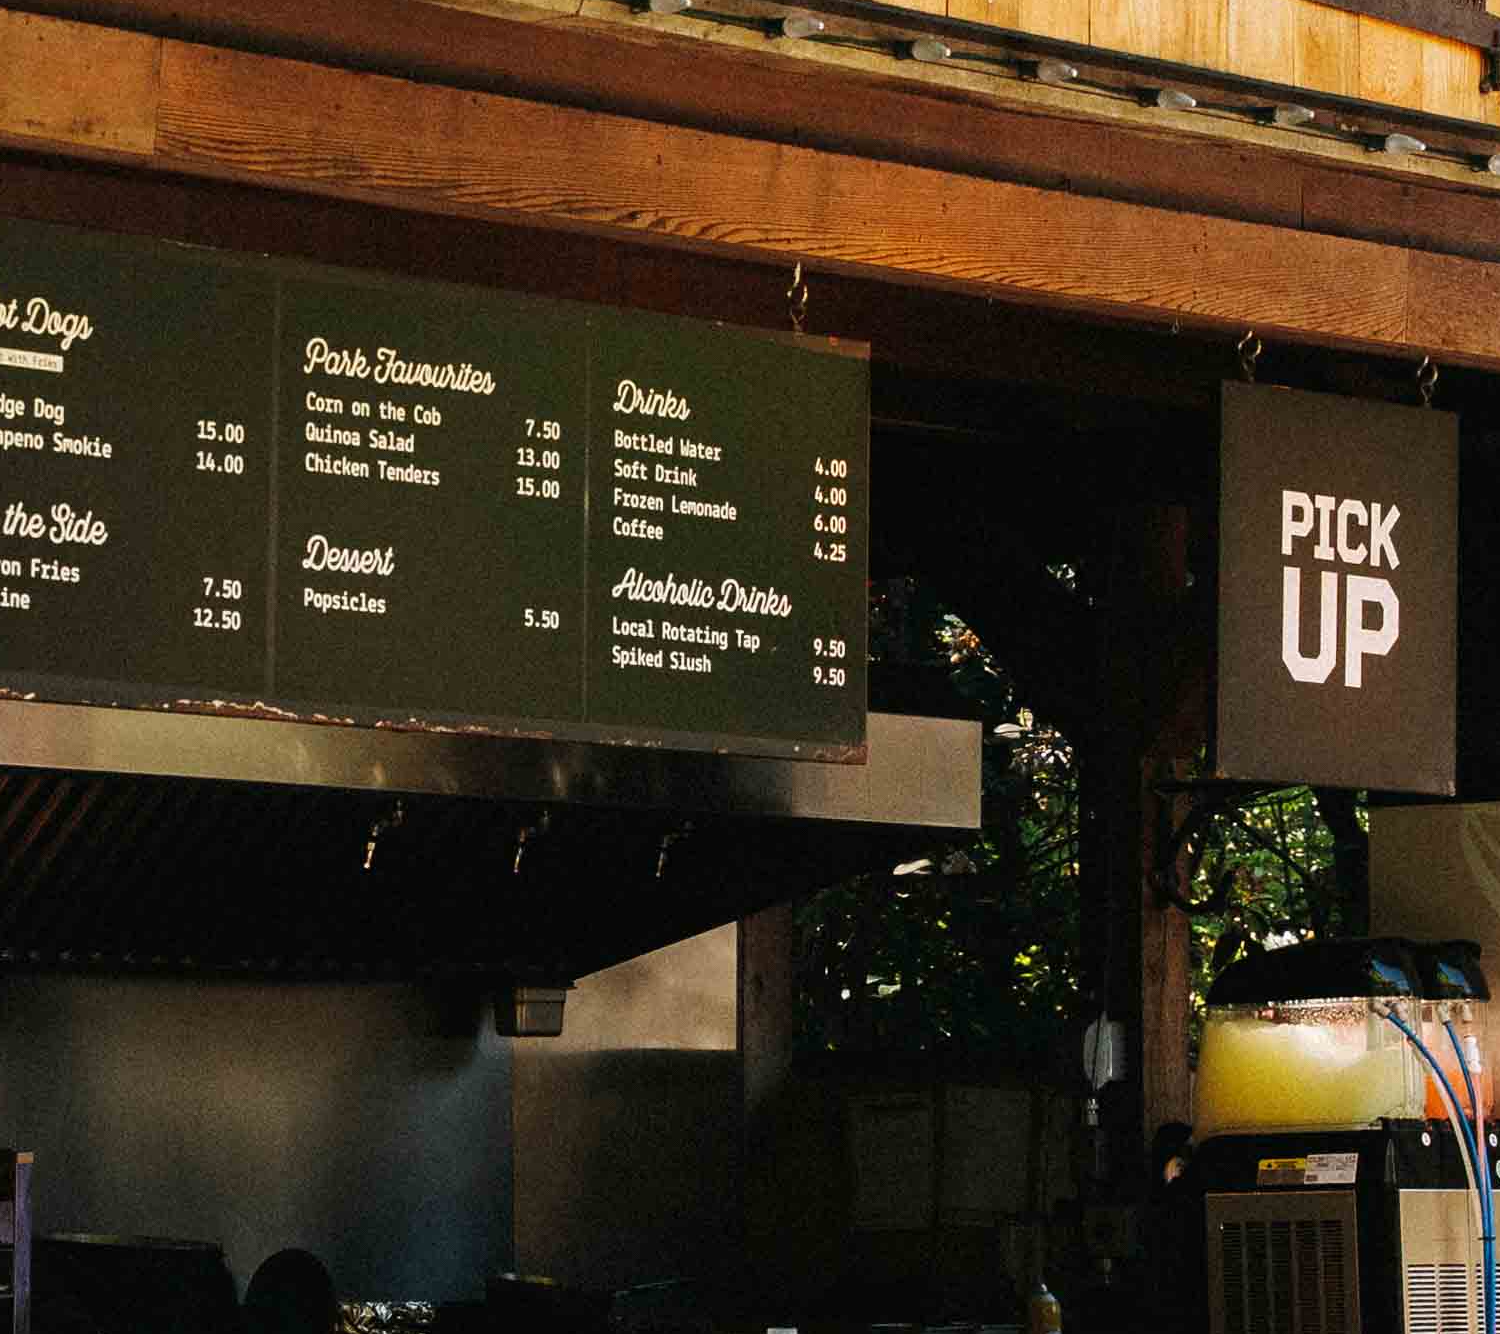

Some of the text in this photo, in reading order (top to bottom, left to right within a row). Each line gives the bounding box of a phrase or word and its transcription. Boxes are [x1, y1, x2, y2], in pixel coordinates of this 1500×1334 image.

[22, 297, 93, 350] Dogs
[304, 338, 496, 395] Park Favourites
[34, 398, 65, 425] Dog
[197, 420, 244, 443] 15.00
[306, 391, 560, 439] Corn on the Cob 7.50
[613, 380, 690, 420] Drinks
[53, 432, 112, 458] Smokie
[196, 451, 243, 474] 14.00
[305, 423, 560, 469] Quinoa Salad 13.00
[615, 430, 847, 478] Bottled Water 4.00
[305, 453, 560, 498] Chicken Tenders 15.00
[614, 459, 846, 506] Soft Drink 4.00
[3, 501, 45, 538] the
[49, 503, 108, 545] Side
[614, 488, 846, 534] Frozen Lemonade 6.00
[1282, 490, 1400, 569] PICK
[302, 535, 394, 576] Dessert
[613, 517, 846, 562] Coffee 4.25
[31, 558, 80, 582] Fries
[203, 577, 242, 599] 7.50
[612, 568, 792, 617] Alcoholic Drinks
[193, 608, 240, 631] 12.50
[304, 588, 559, 629] Popsicles 5.50
[1282, 572, 1400, 688] UP
[612, 617, 845, 658] Local Rotating Tap 9.50
[612, 646, 845, 686] Spiked Slush 9.50
